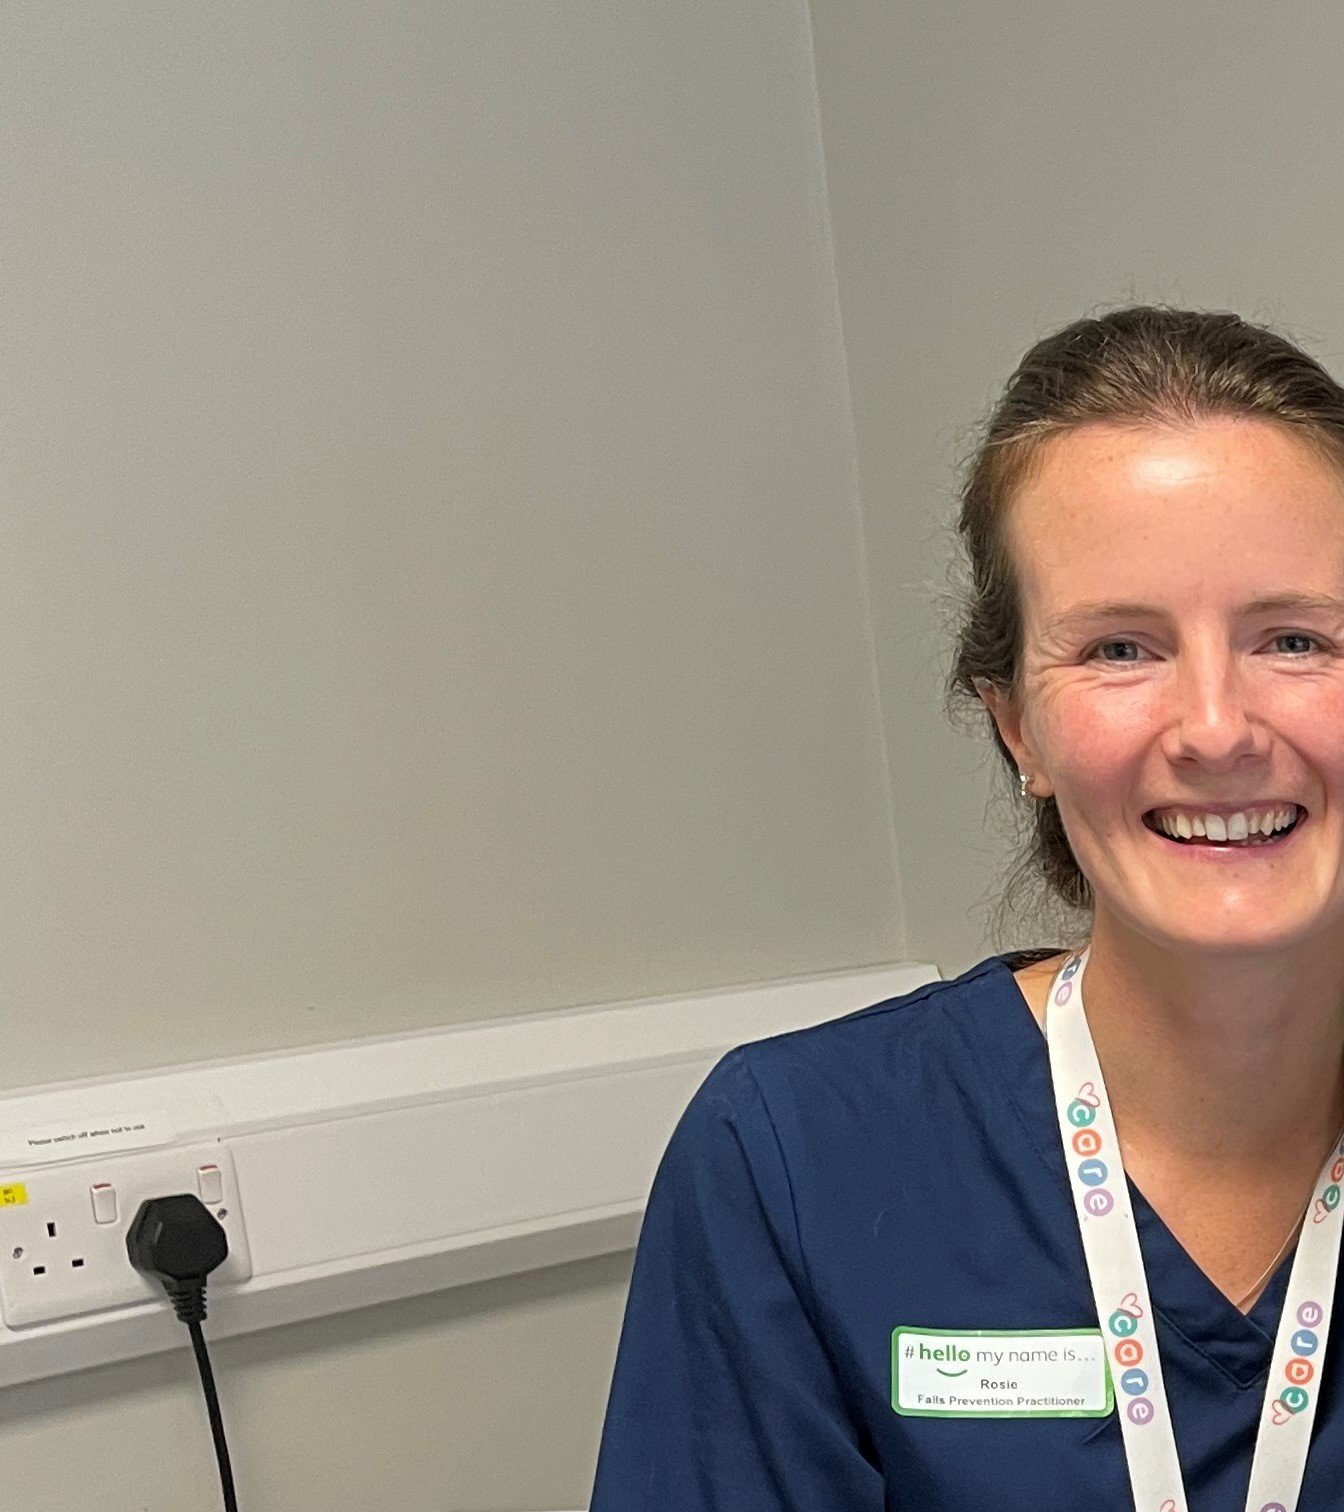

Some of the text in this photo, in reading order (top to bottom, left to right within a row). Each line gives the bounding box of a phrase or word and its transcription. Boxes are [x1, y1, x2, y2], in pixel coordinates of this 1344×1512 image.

[1069, 1102, 1113, 1215] care
[919, 1343, 971, 1363] hello
[977, 1350, 1004, 1366] my
[1009, 1350, 1058, 1363] name
[980, 1379, 1018, 1390] Rosie
[1110, 1310, 1153, 1424] care
[1282, 1303, 1322, 1412] care
[918, 1394, 1085, 1406] Falls Prevention Practitioner
